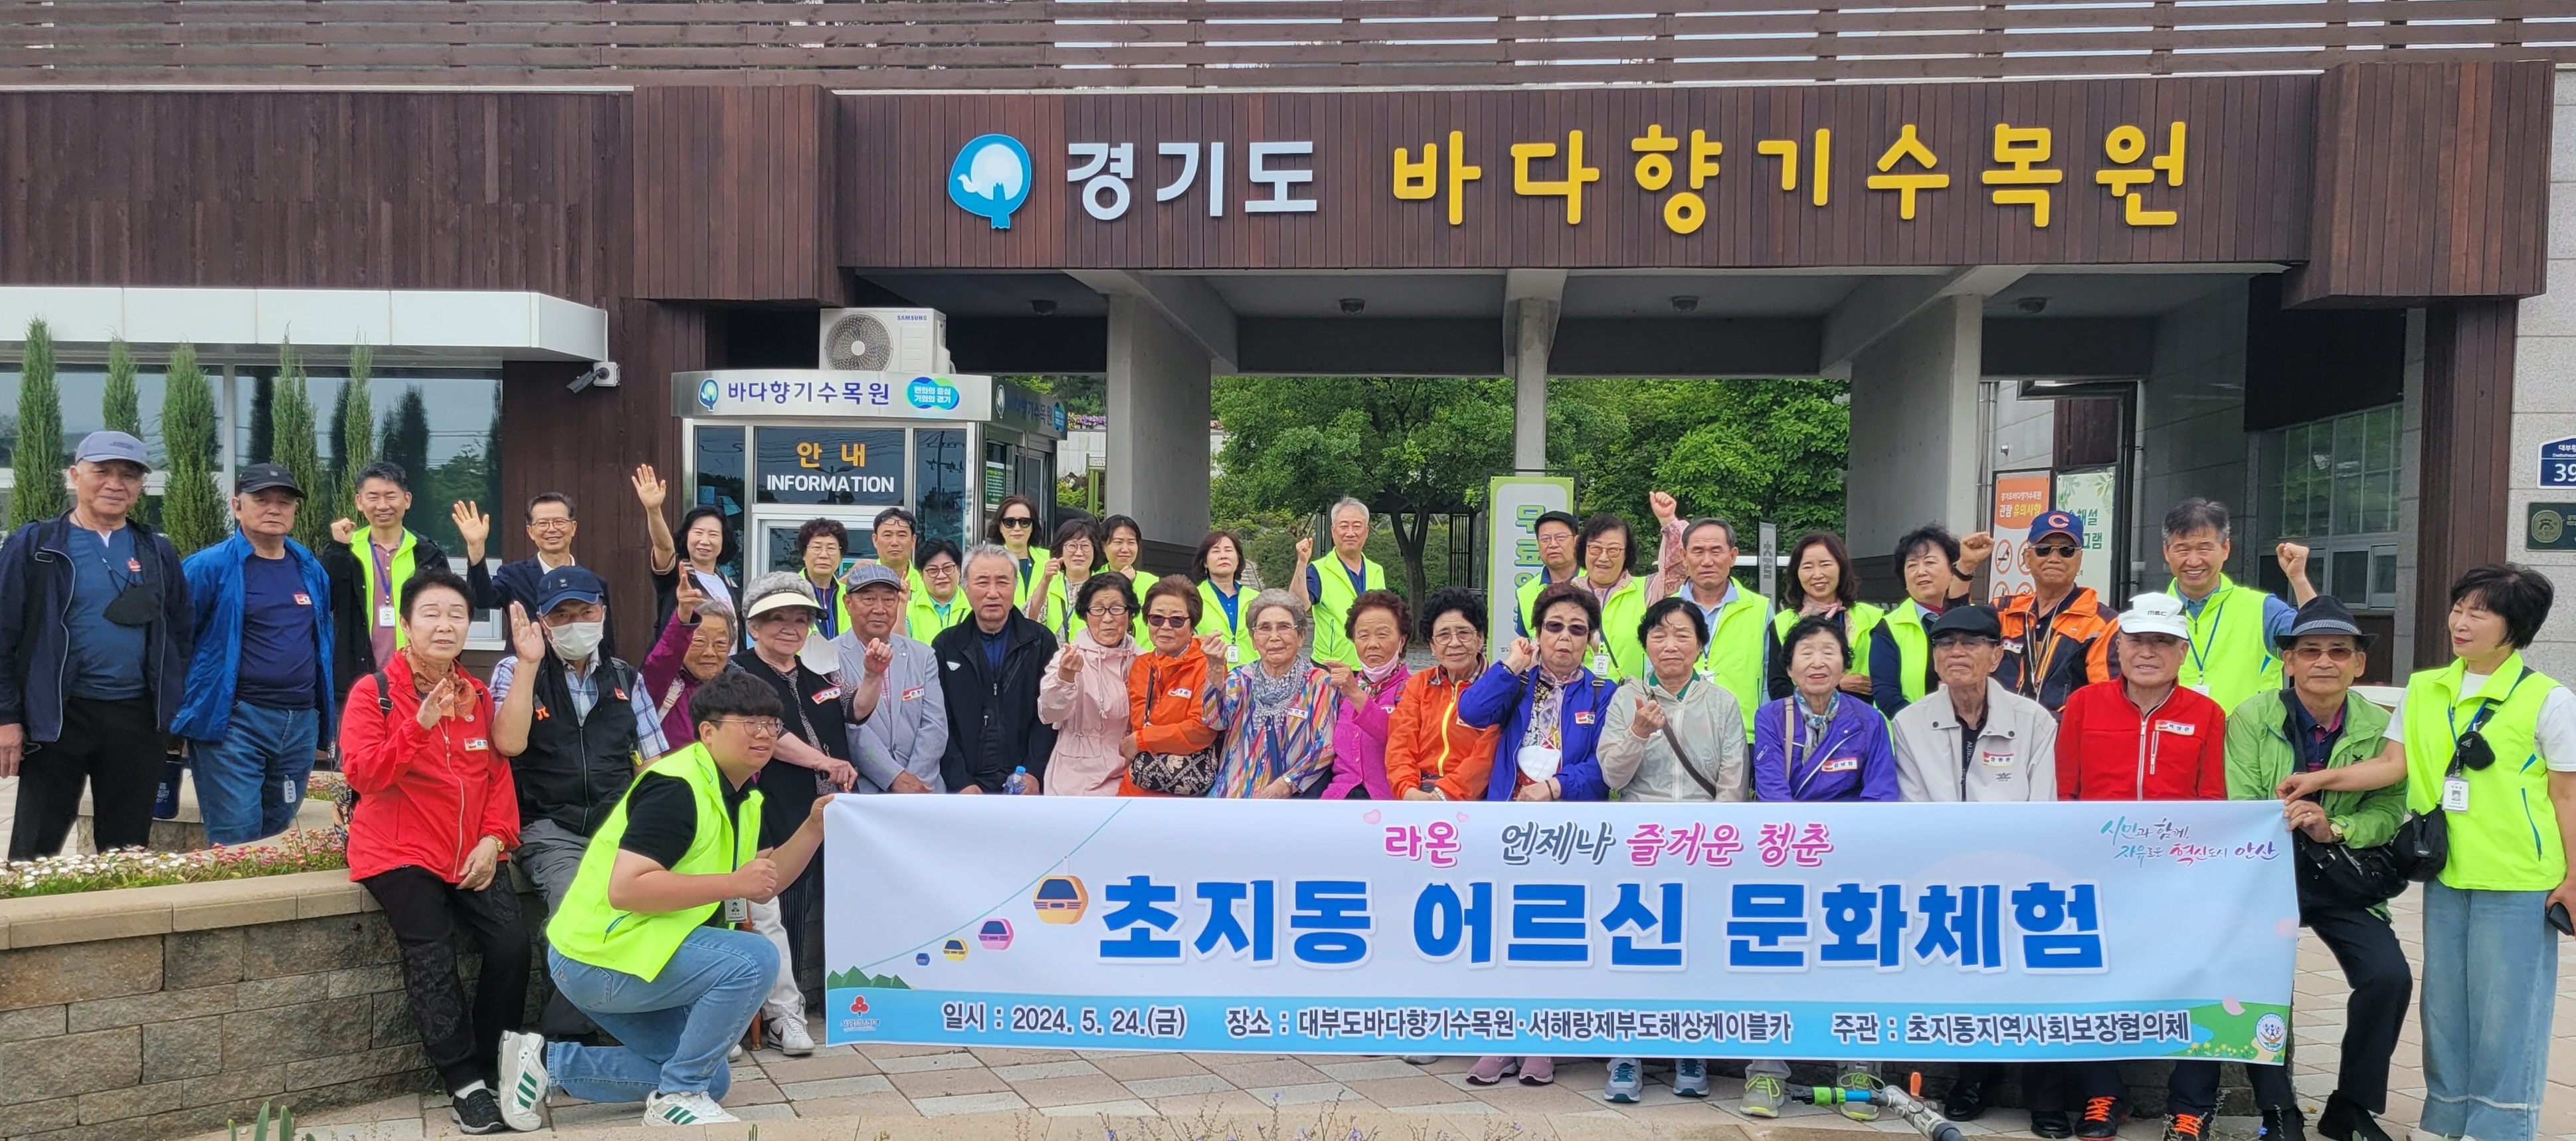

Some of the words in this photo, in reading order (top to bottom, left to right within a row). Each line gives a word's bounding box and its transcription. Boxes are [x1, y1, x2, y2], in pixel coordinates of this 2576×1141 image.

[1067, 140, 1317, 221] 경기도
[1393, 121, 2187, 234] 바다향기수목원
[728, 381, 889, 405] 바다향기수목원
[767, 474, 895, 493] INFORMATION
[1999, 504, 2012, 518] 관람
[2013, 502, 2042, 517] 유의사항
[2048, 515, 2070, 528] C
[1384, 821, 1461, 866] 라온
[1501, 821, 1615, 865] 언제나
[1625, 823, 1744, 866] 즐거운
[1756, 823, 1834, 866] 청춘
[2100, 815, 2153, 845] 시민과
[2113, 844, 2164, 868] 자유로운
[2169, 843, 2227, 867] 혁신도시
[2234, 841, 2280, 860] 안산
[1099, 875, 1371, 964] 초지동
[1414, 882, 1683, 966] 어르신
[1726, 881, 2104, 969] 문화체험
[943, 1003, 984, 1031] 일시
[1013, 1007, 1073, 1032] 2024.
[1081, 1008, 1101, 1033] 5.
[1113, 1006, 1186, 1039] 24.(금)
[1228, 1010, 1270, 1038] 장소
[1833, 1015, 1879, 1043] 주관
[1906, 1011, 2189, 1045] 초지동지역사회보장협의체
